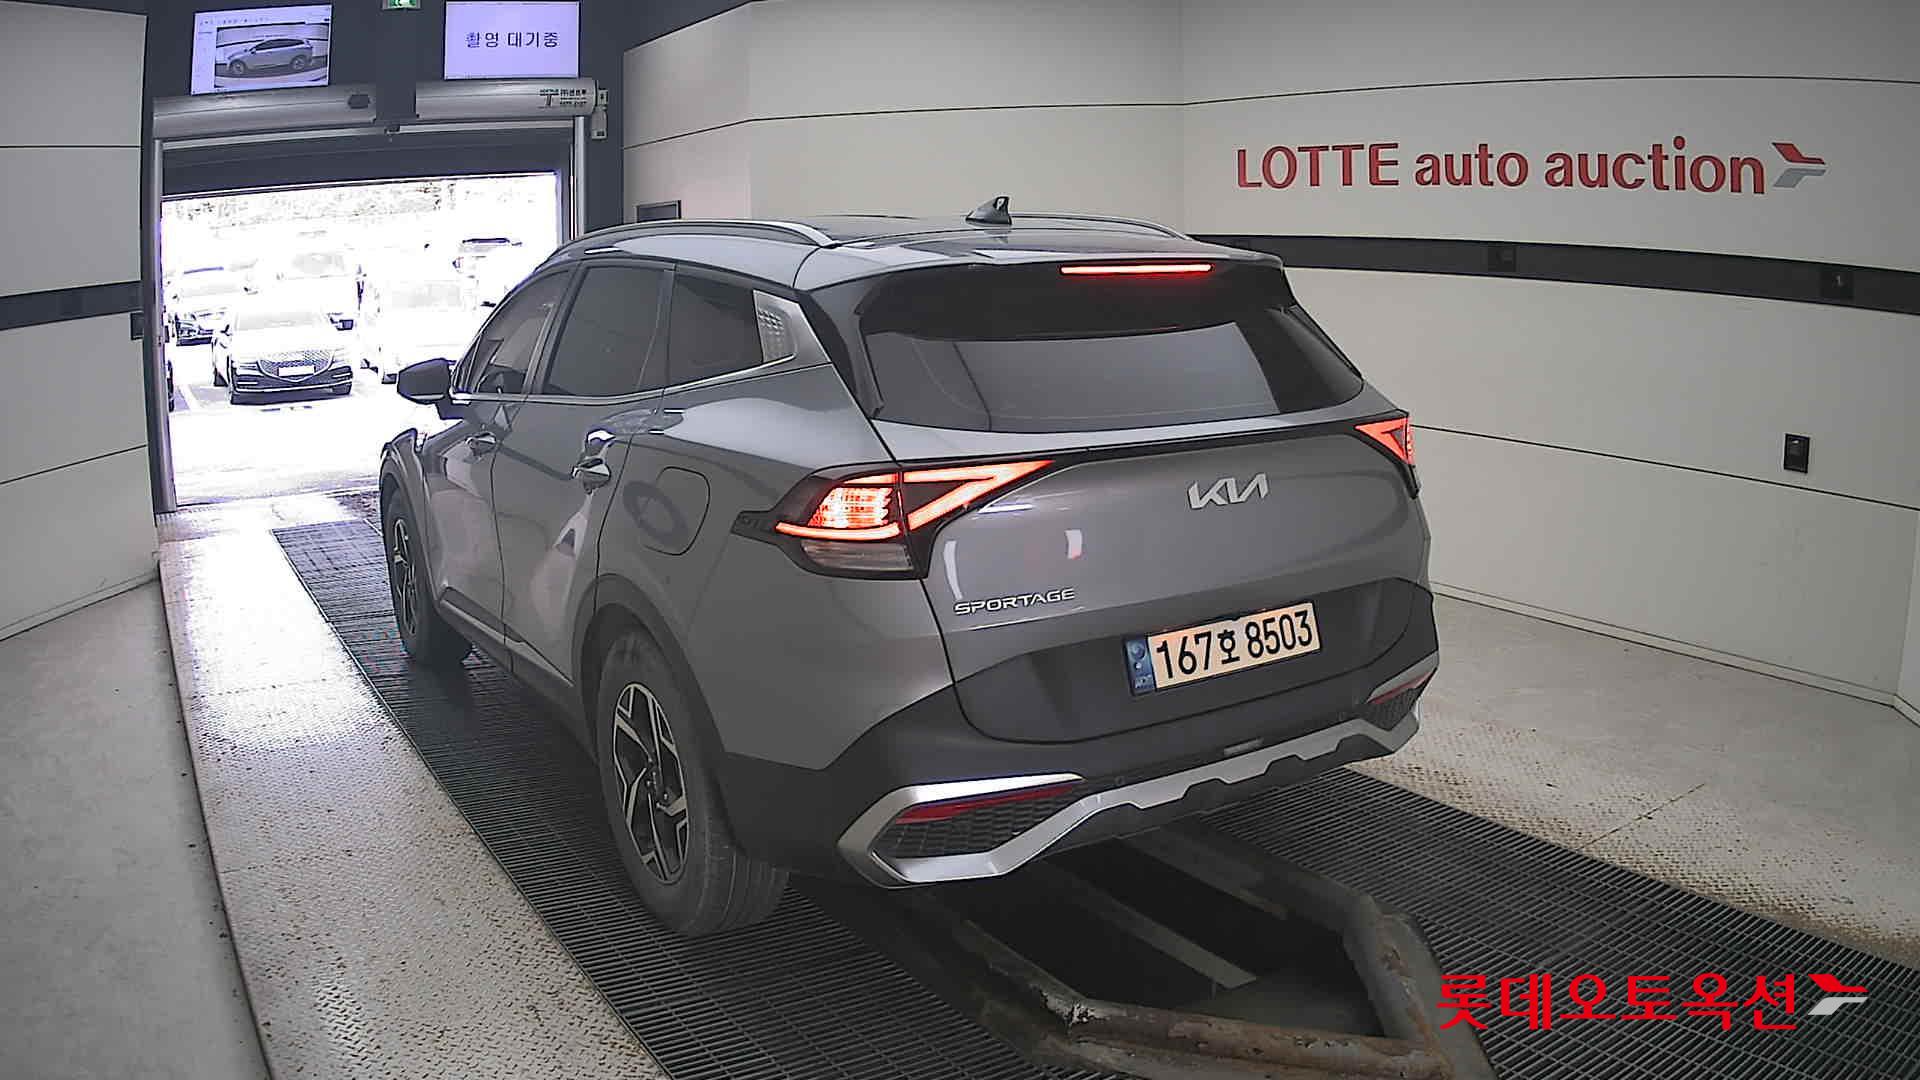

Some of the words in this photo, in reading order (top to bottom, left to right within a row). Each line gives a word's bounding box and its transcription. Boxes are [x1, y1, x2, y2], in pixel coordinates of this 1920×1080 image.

[507, 32, 558, 48] 대기중
[1236, 142, 1399, 189] LOTTE
[1414, 143, 1529, 188] auto
[1544, 136, 1766, 195] auction
[1187, 473, 1269, 510] KIA
[954, 588, 1075, 615] SPORTAGE
[1156, 628, 1241, 679] 167호
[1245, 609, 1314, 659] 8503
